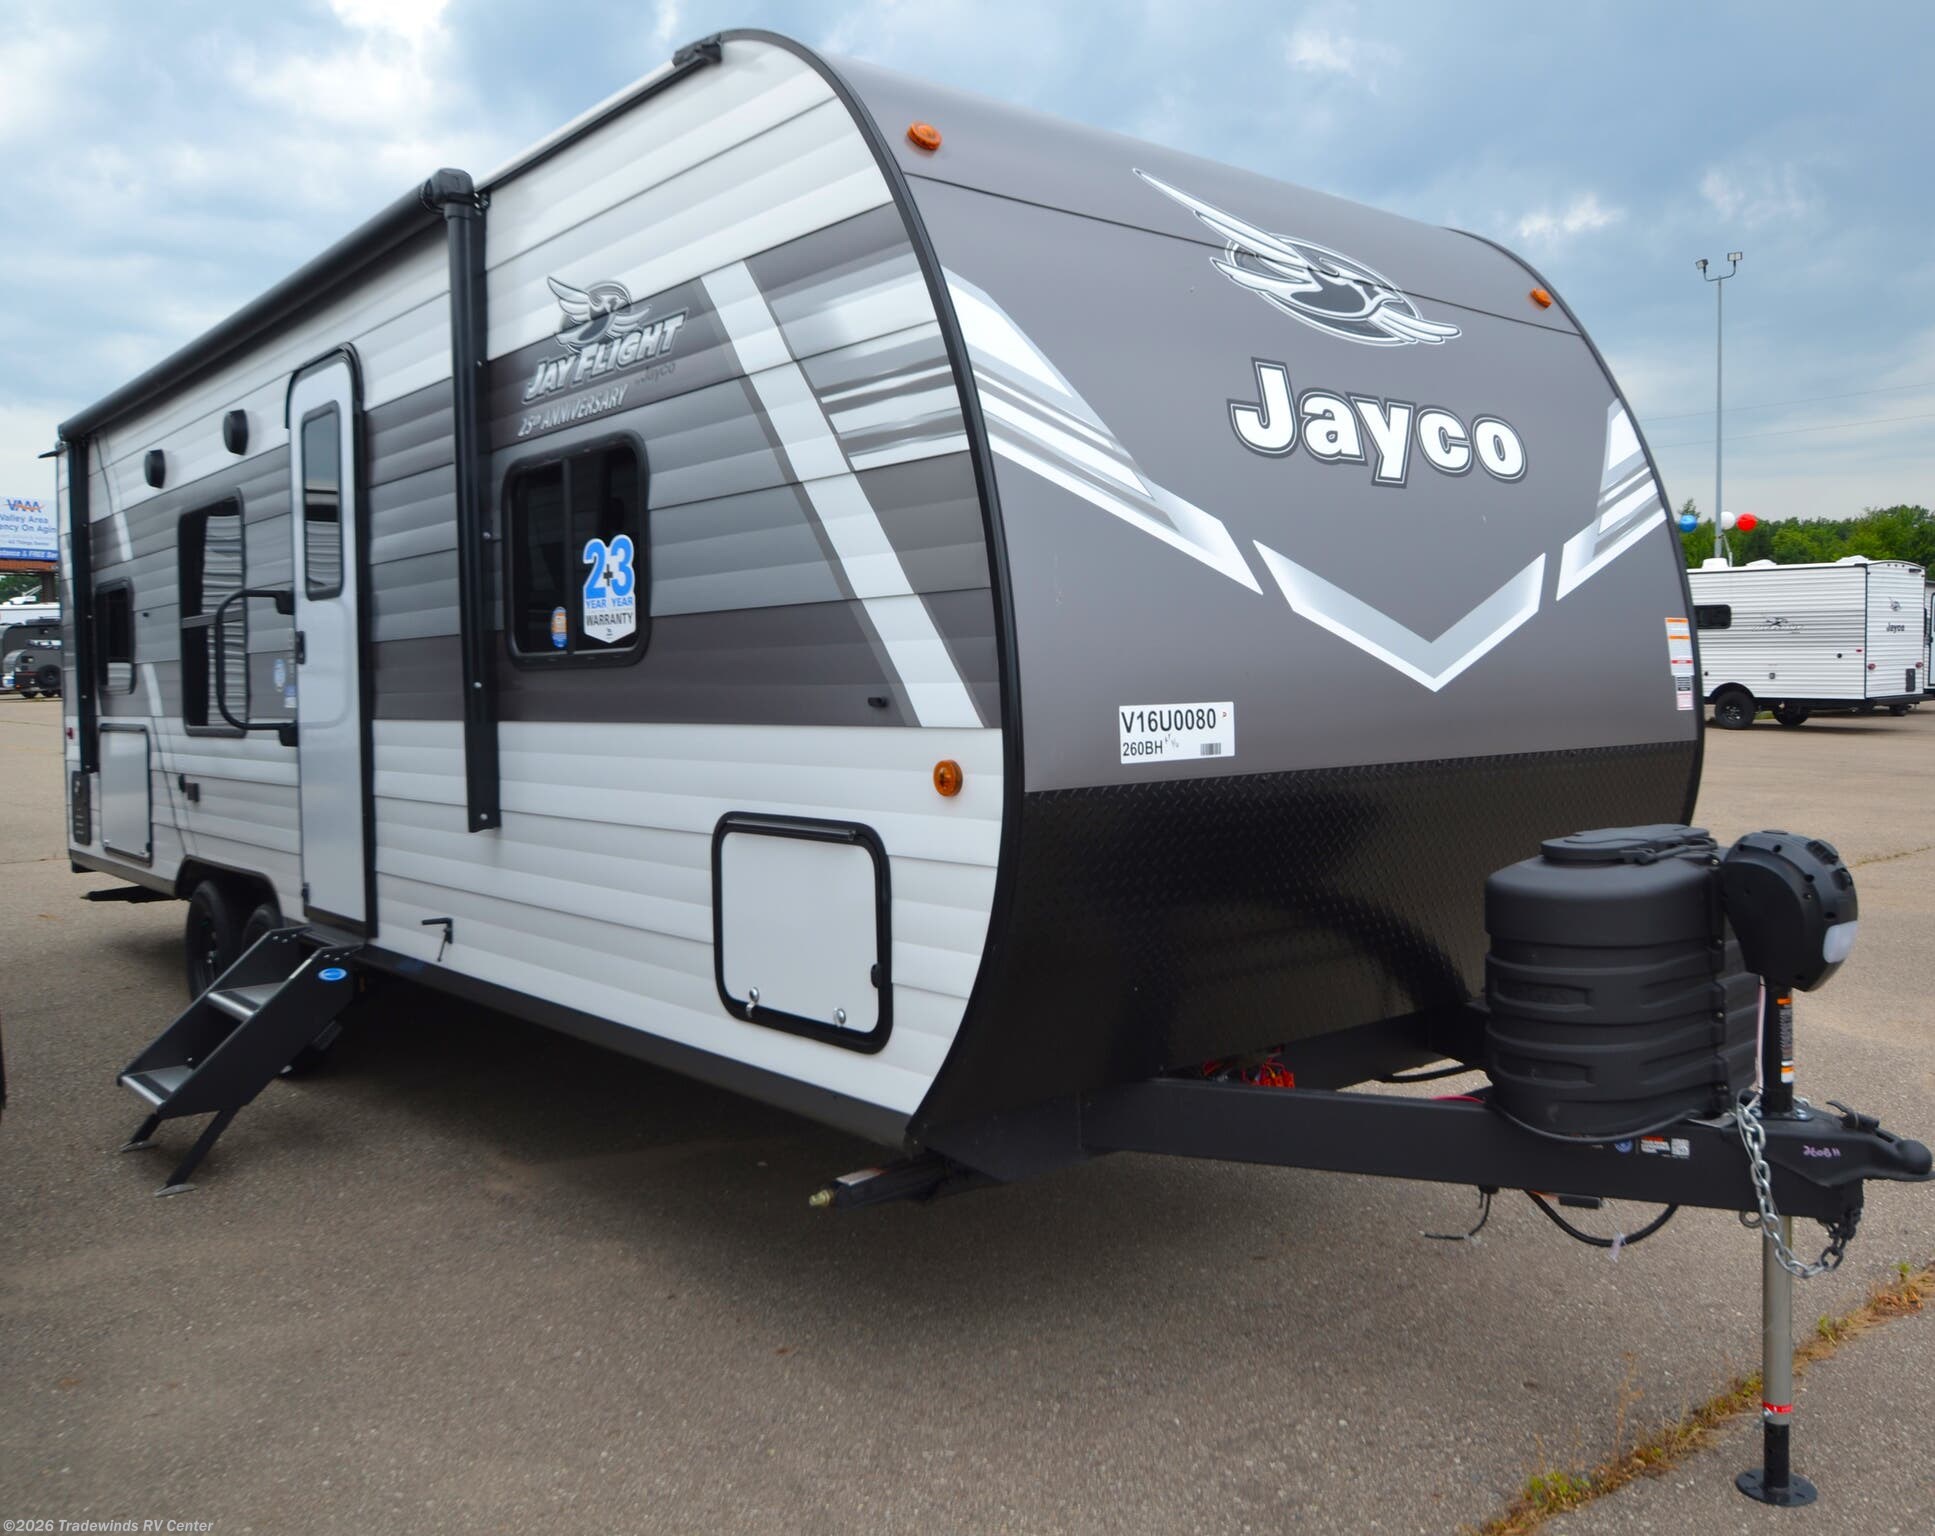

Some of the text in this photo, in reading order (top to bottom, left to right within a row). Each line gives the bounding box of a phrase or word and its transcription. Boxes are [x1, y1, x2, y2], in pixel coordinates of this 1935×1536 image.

[523, 312, 687, 404] JAY FLIGHT
[540, 383, 628, 431] ANNIVERSARY
[1228, 357, 1528, 488] Jayco
[586, 596, 633, 609] YEAR YEAR
[586, 612, 633, 626] WARRANTY
[1121, 708, 1216, 733] V16U0080
[1123, 740, 1163, 756] 260BH
